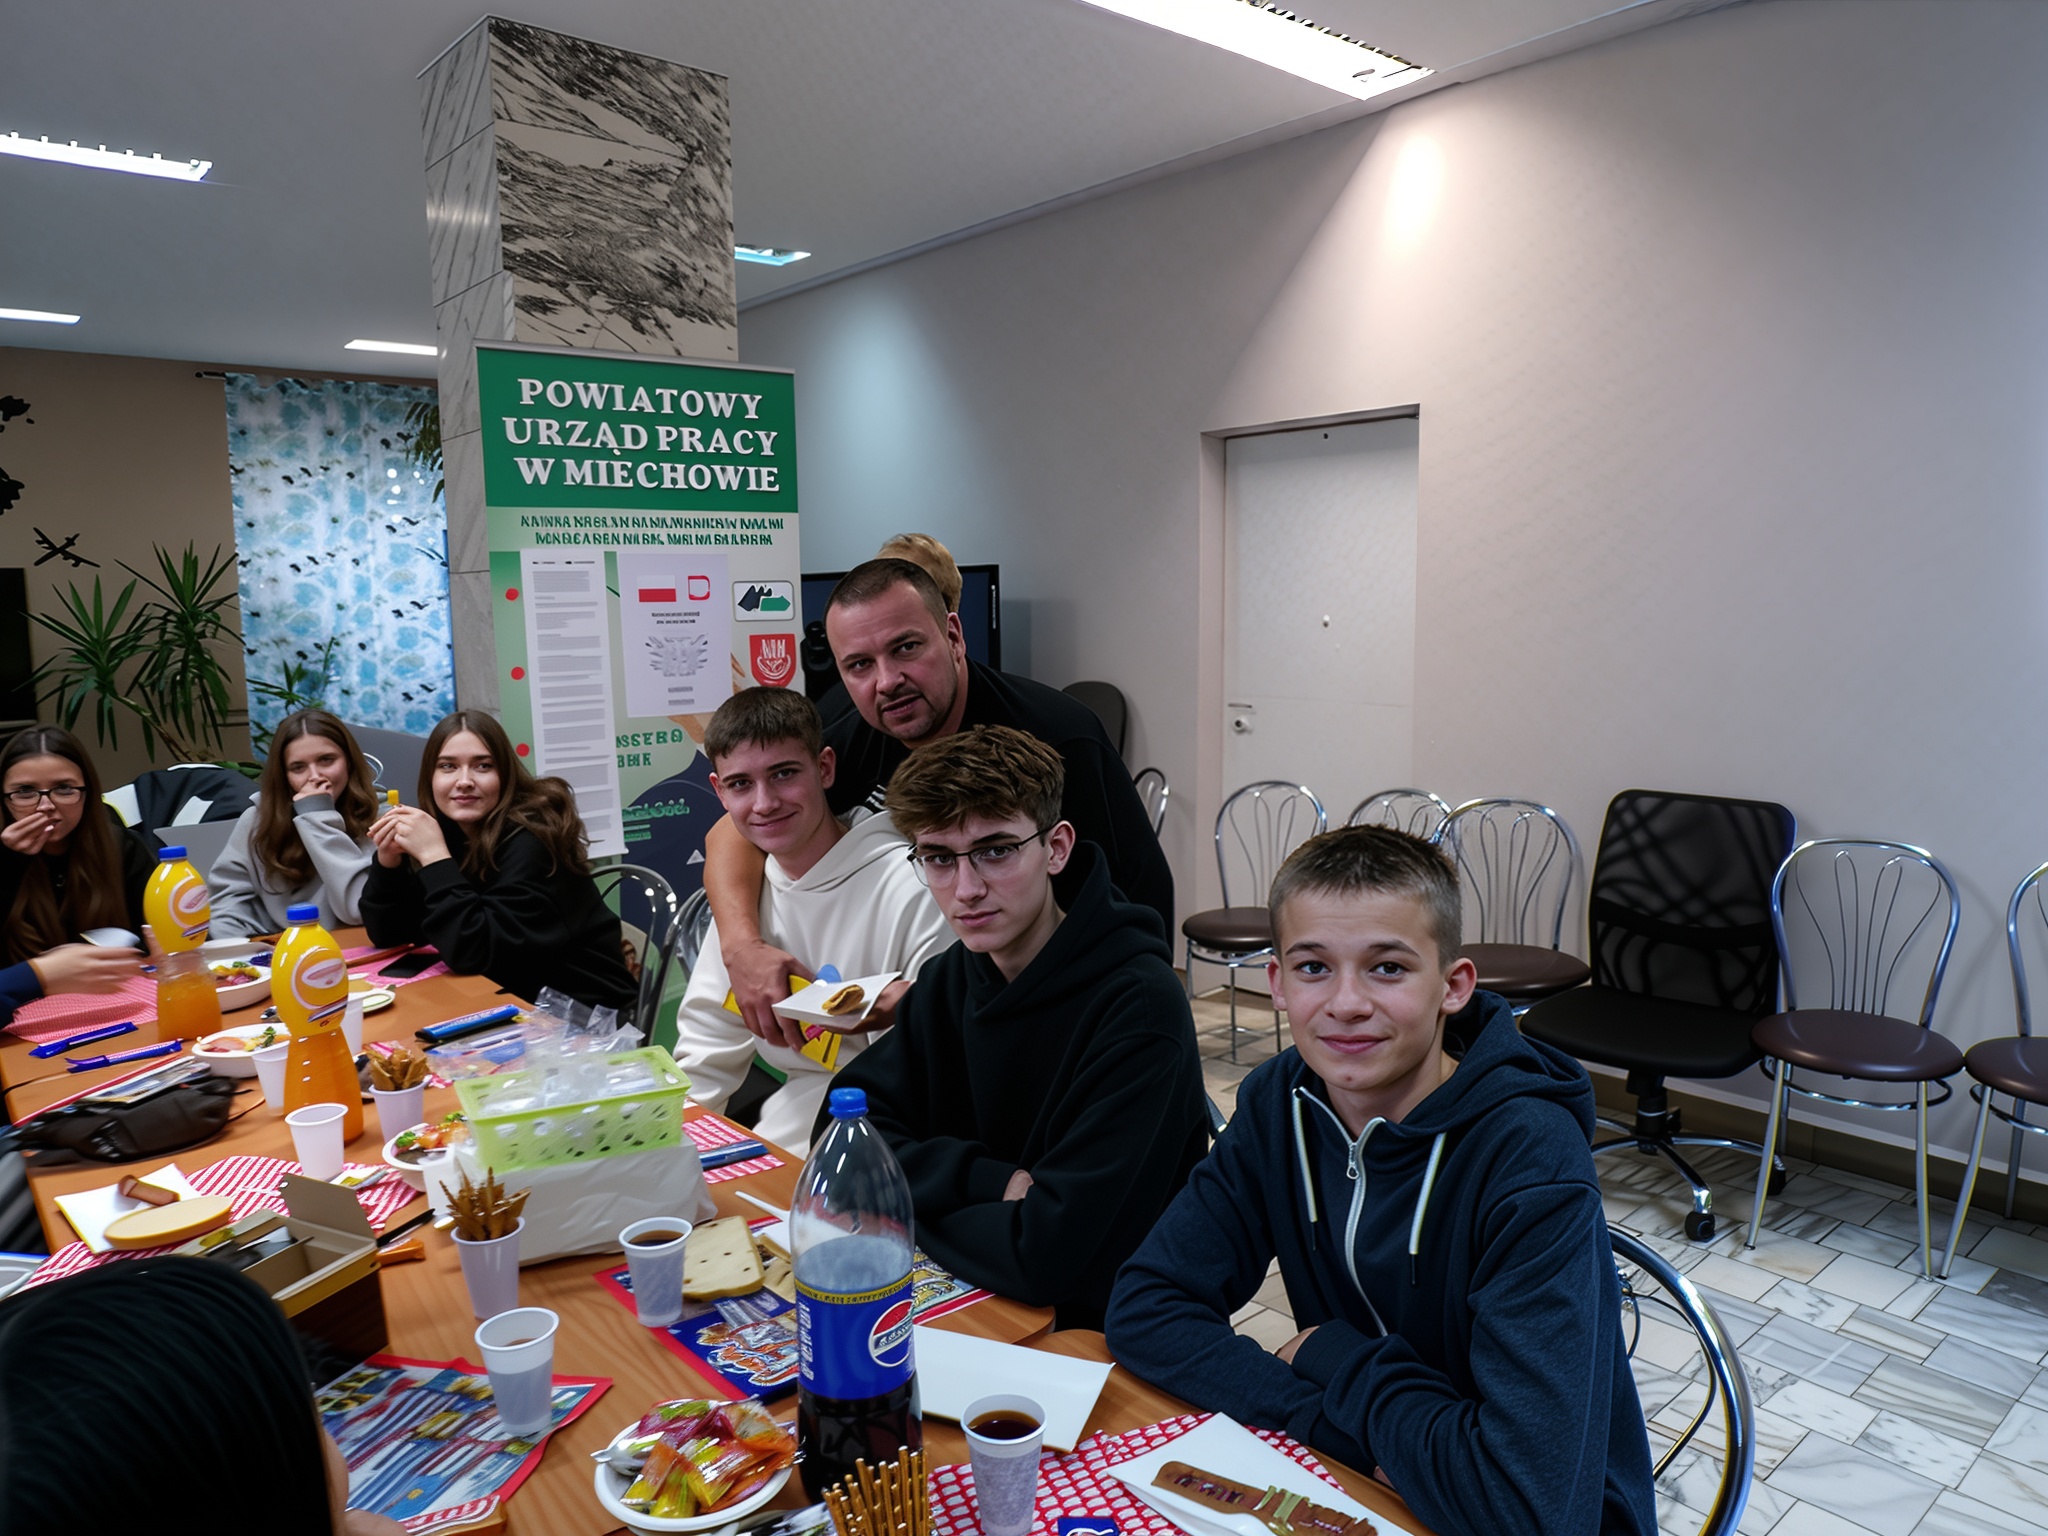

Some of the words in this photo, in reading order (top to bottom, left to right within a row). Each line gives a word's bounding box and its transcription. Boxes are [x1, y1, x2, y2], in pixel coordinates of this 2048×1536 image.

[517, 378, 763, 419] POWIATOWY
[502, 416, 648, 456] URZĄD
[655, 425, 778, 456] PRACY
[513, 457, 555, 485] W
